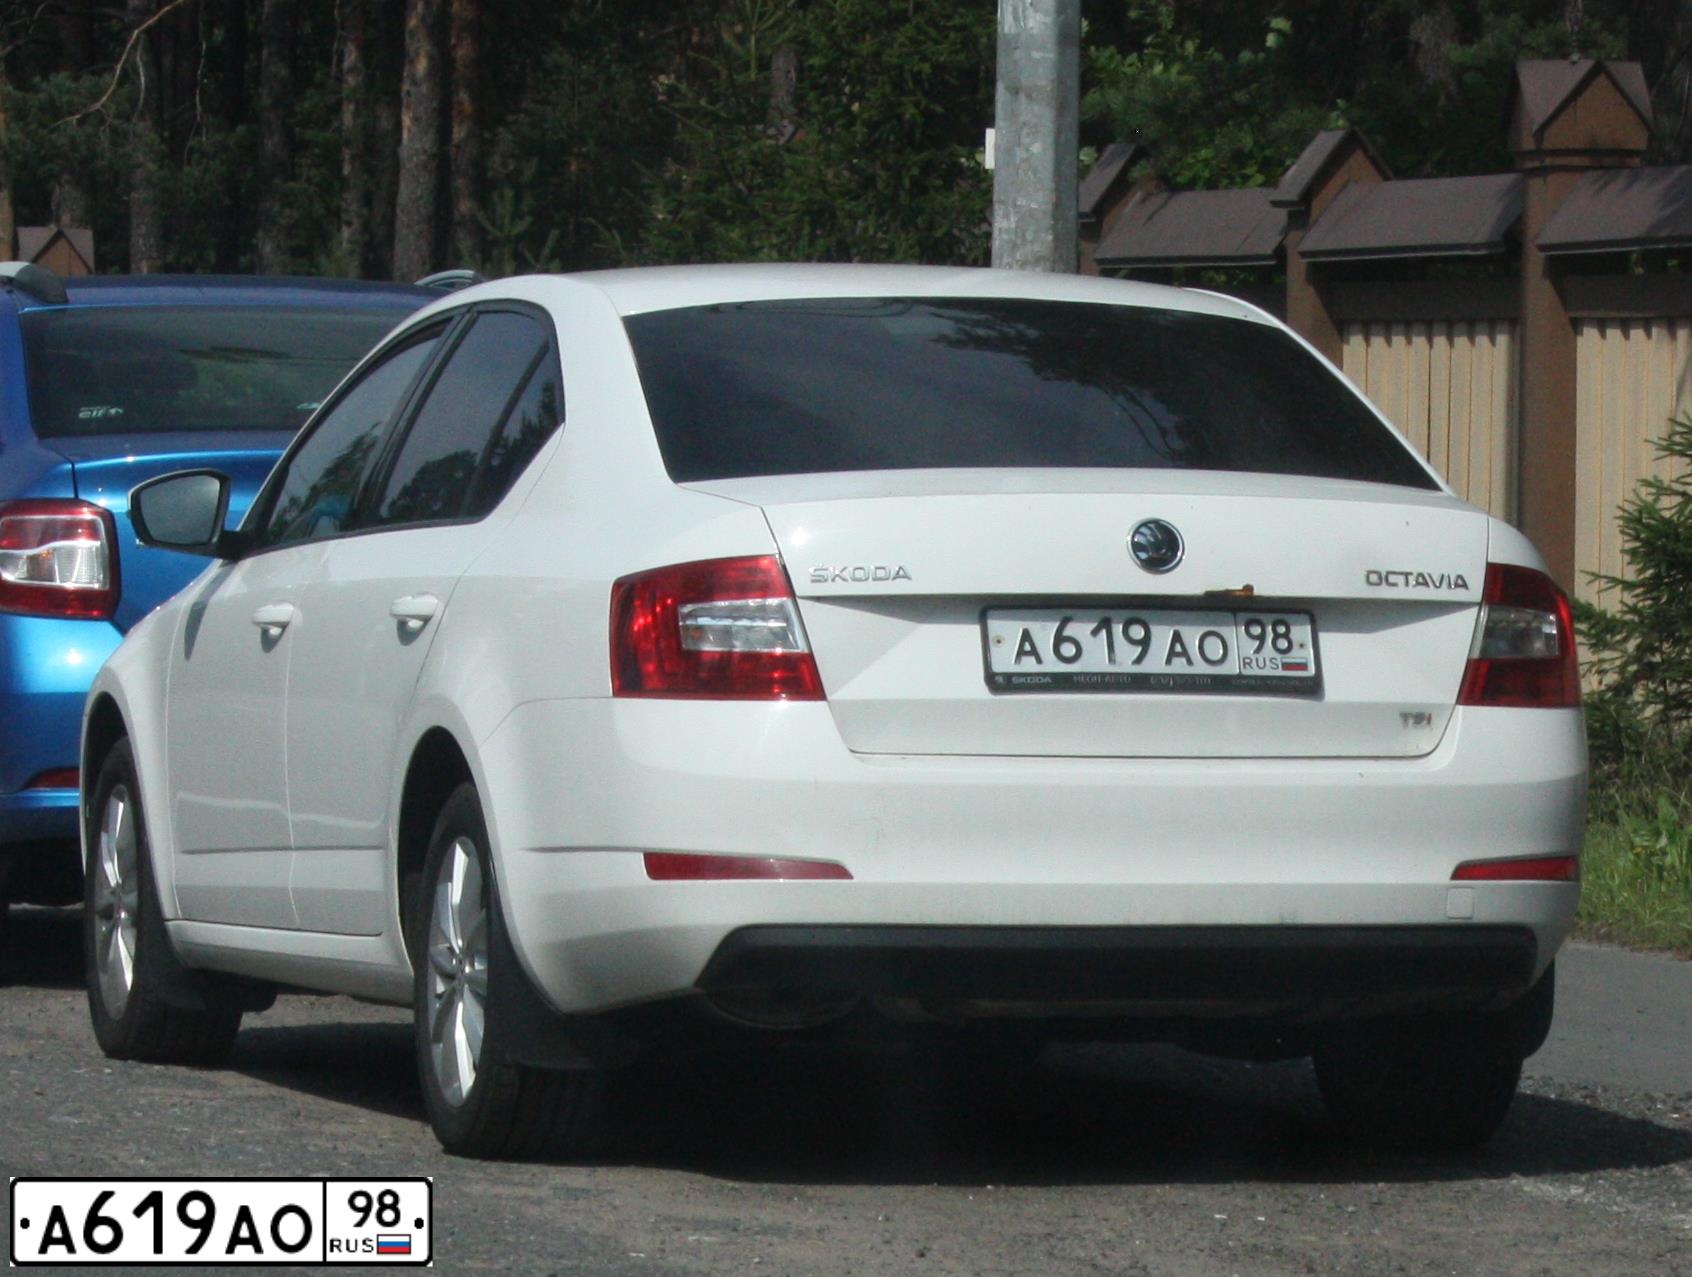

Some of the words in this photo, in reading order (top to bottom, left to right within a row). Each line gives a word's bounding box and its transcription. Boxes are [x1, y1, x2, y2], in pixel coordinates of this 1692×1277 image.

[1366, 570, 1469, 591] OCTAVIA
[1243, 618, 1293, 655] 98
[1242, 656, 1280, 670] RUS
